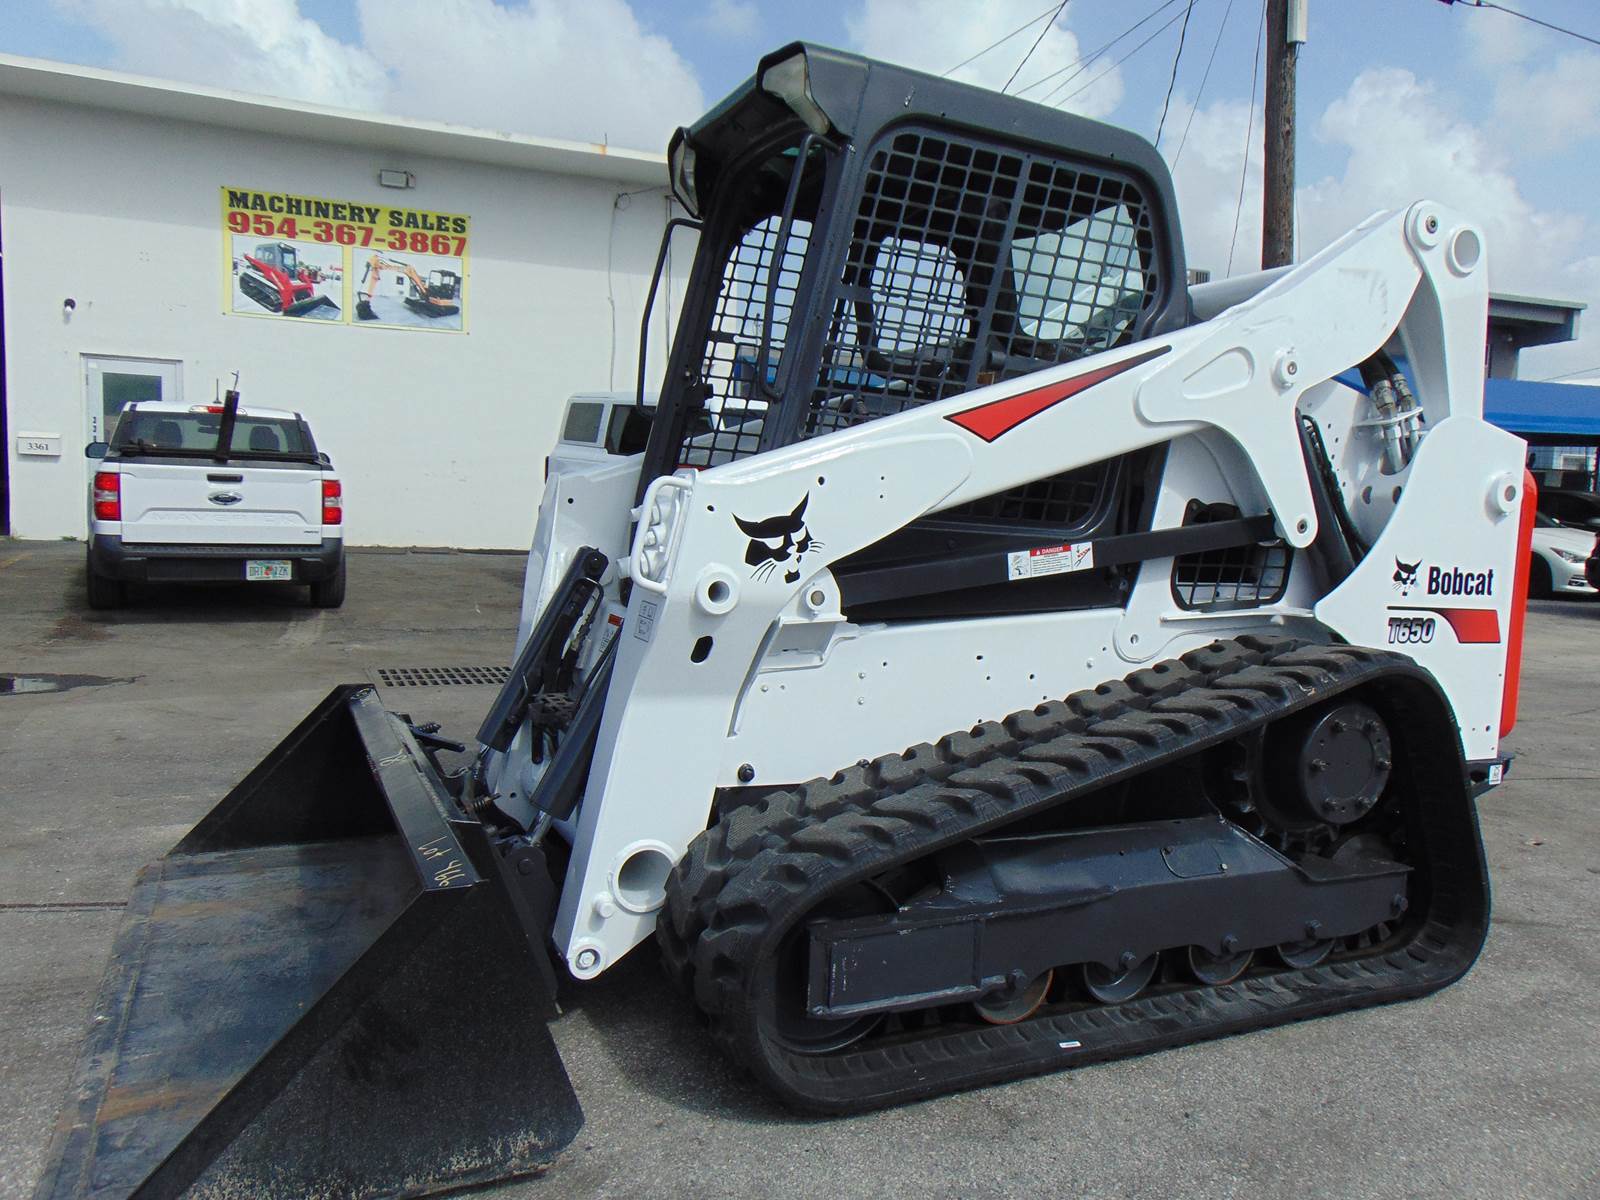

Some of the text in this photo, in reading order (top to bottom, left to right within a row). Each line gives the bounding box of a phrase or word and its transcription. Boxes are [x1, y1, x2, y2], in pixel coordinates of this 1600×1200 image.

[227, 190, 467, 233] MACHINERY SALES
[227, 211, 467, 257] 954-367-3867
[27, 442, 49, 451] 3361
[1041, 547, 1064, 555] DANGER
[1427, 566, 1493, 595] Bobcat
[1388, 617, 1436, 644] T650
